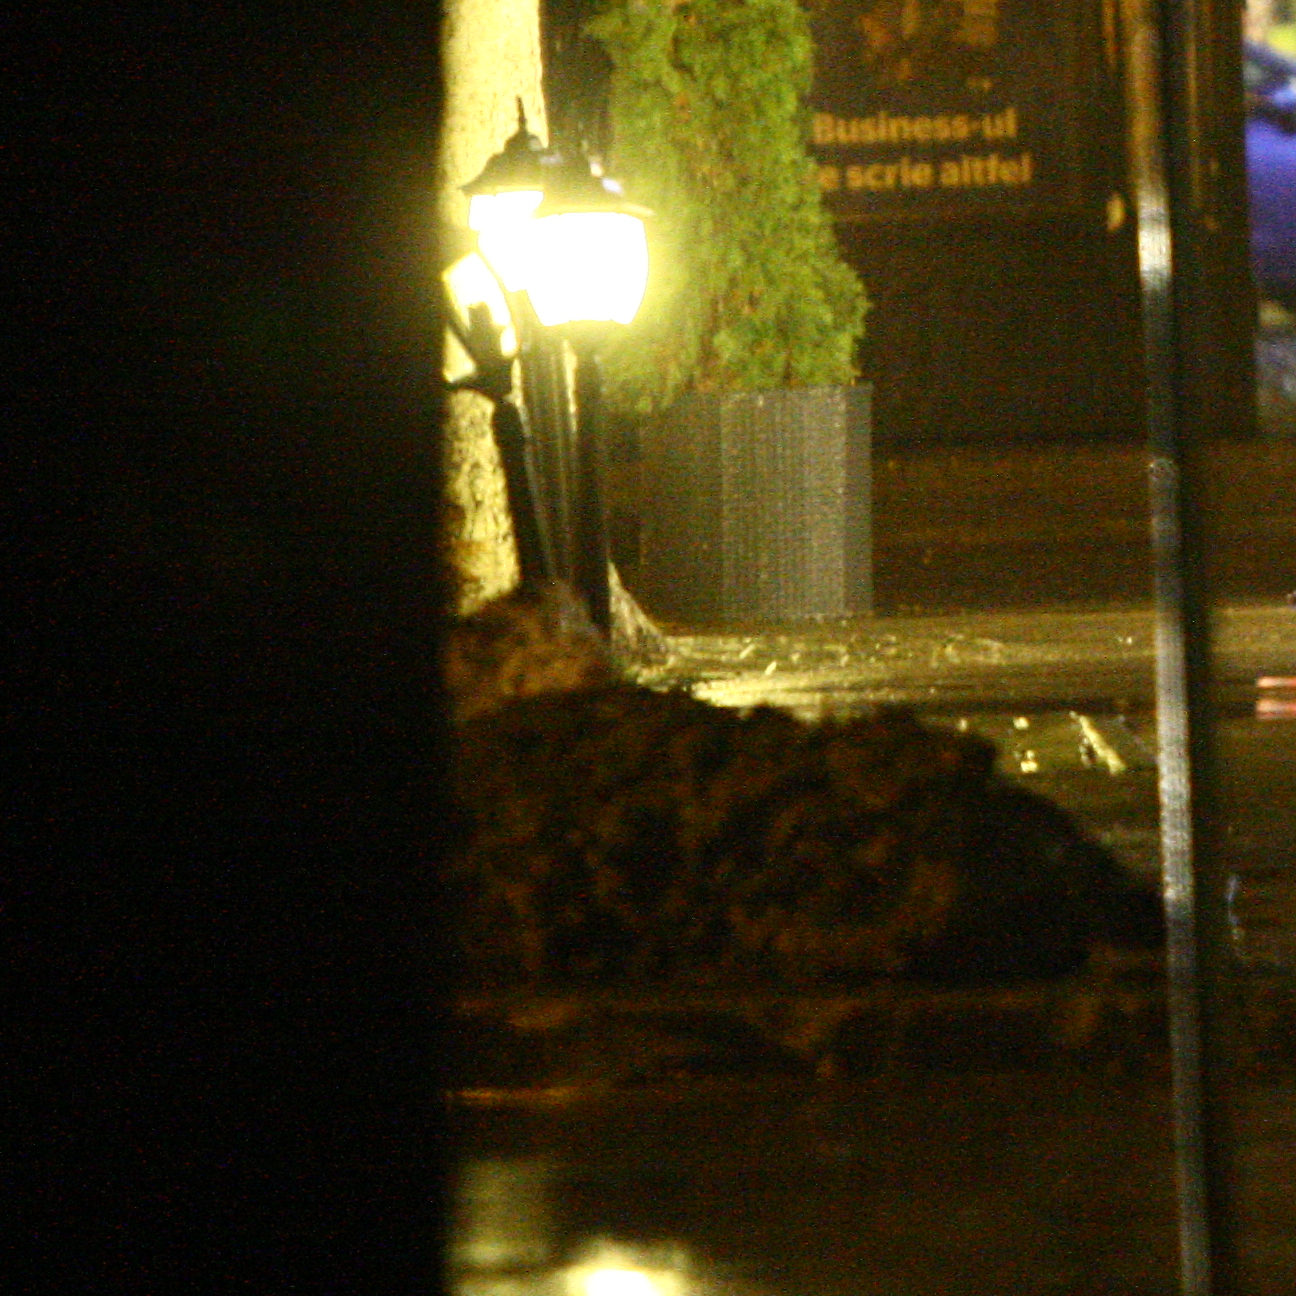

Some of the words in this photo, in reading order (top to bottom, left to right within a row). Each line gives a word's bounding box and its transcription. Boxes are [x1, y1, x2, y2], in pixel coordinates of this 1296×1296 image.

[812, 106, 1018, 144] Business-ul
[845, 154, 934, 190] scrie
[940, 150, 1033, 187] altfel
